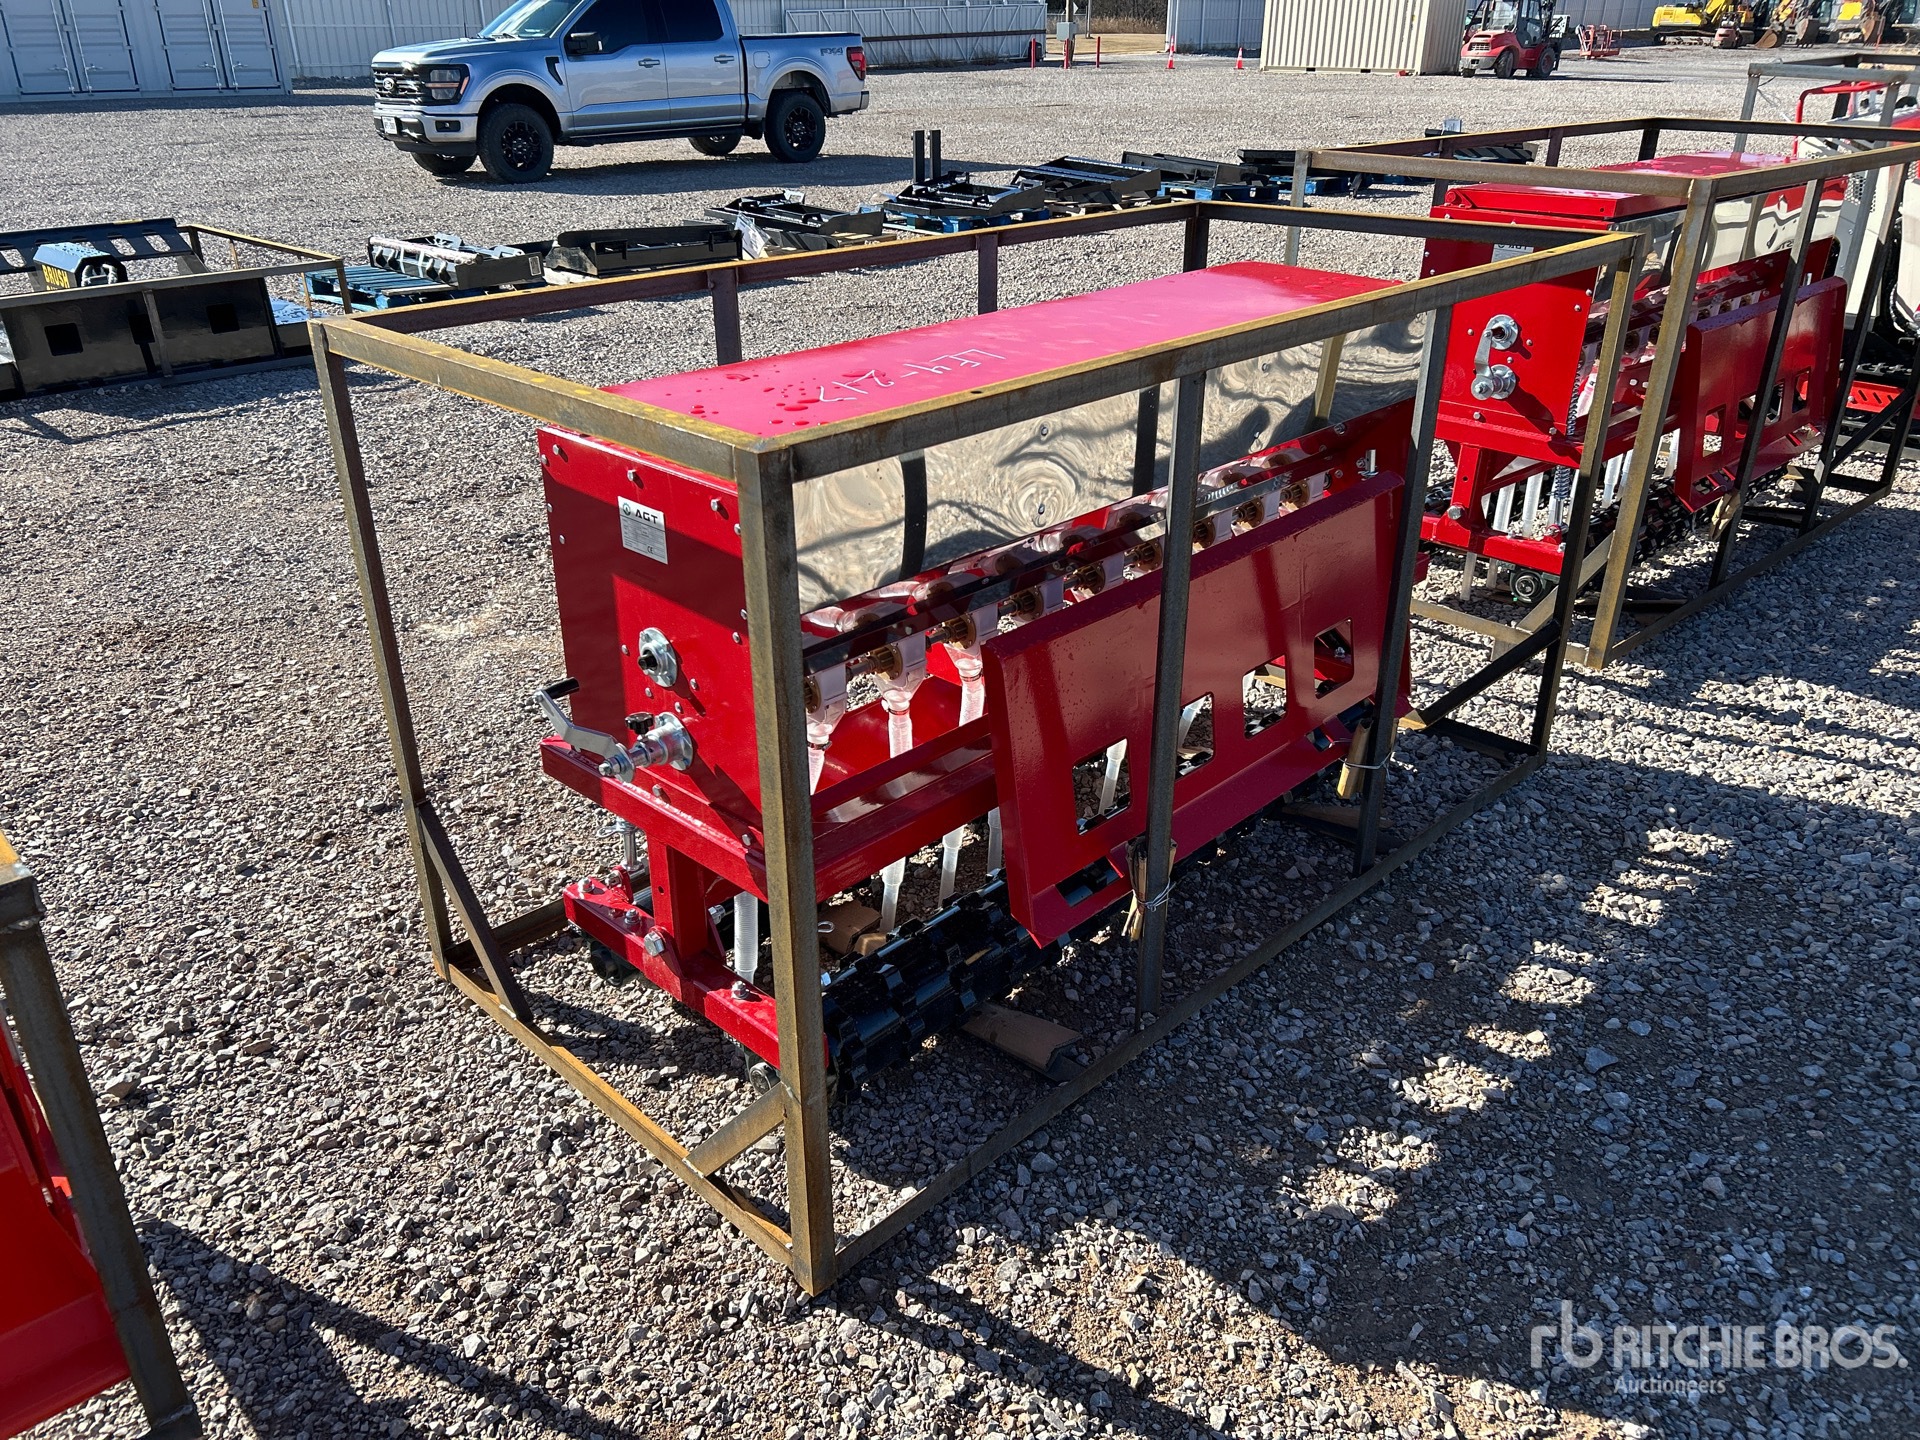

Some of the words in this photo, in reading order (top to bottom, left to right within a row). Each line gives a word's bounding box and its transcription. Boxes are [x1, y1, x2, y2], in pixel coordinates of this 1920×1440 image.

[820, 47, 844, 56] FX4
[41, 264, 70, 289] BRUSH
[635, 509, 658, 524] AGT
